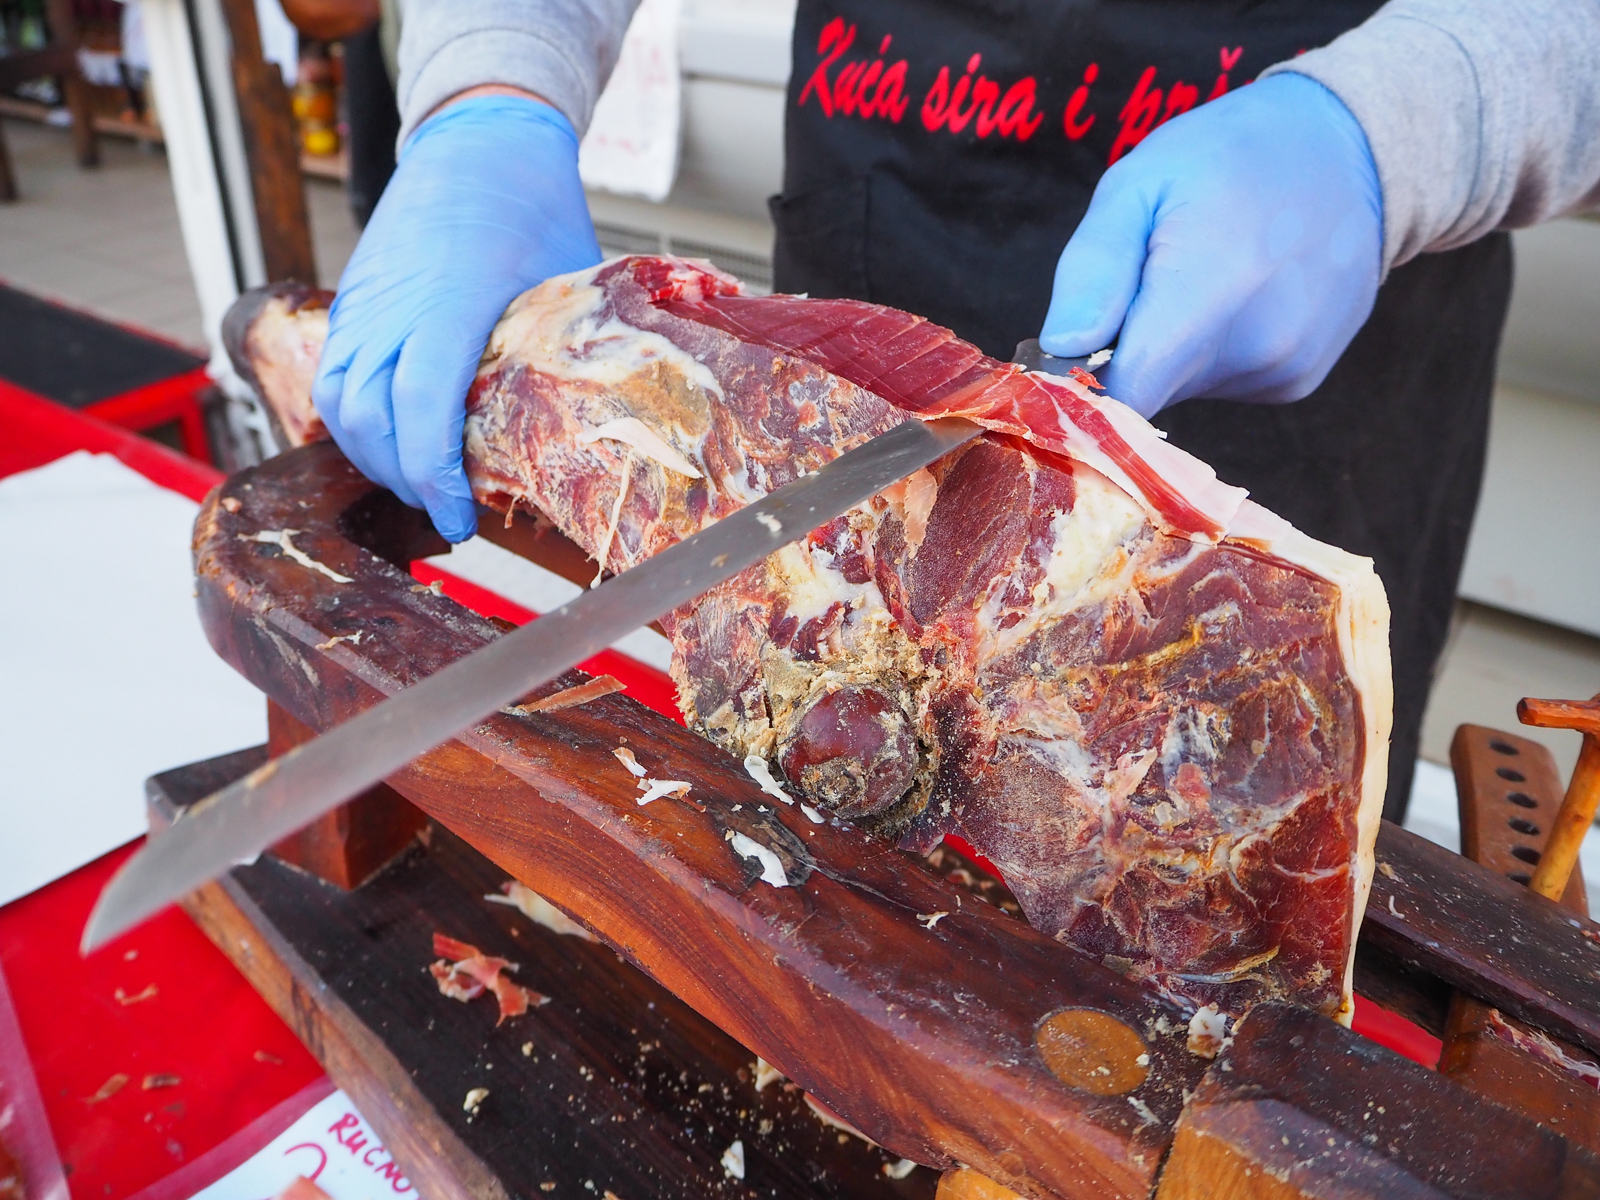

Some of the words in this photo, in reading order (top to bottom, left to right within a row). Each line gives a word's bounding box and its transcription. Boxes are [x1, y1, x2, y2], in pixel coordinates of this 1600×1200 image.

[798, 16, 910, 124] Kuća
[920, 53, 1044, 142] sira
[1063, 62, 1099, 141] i
